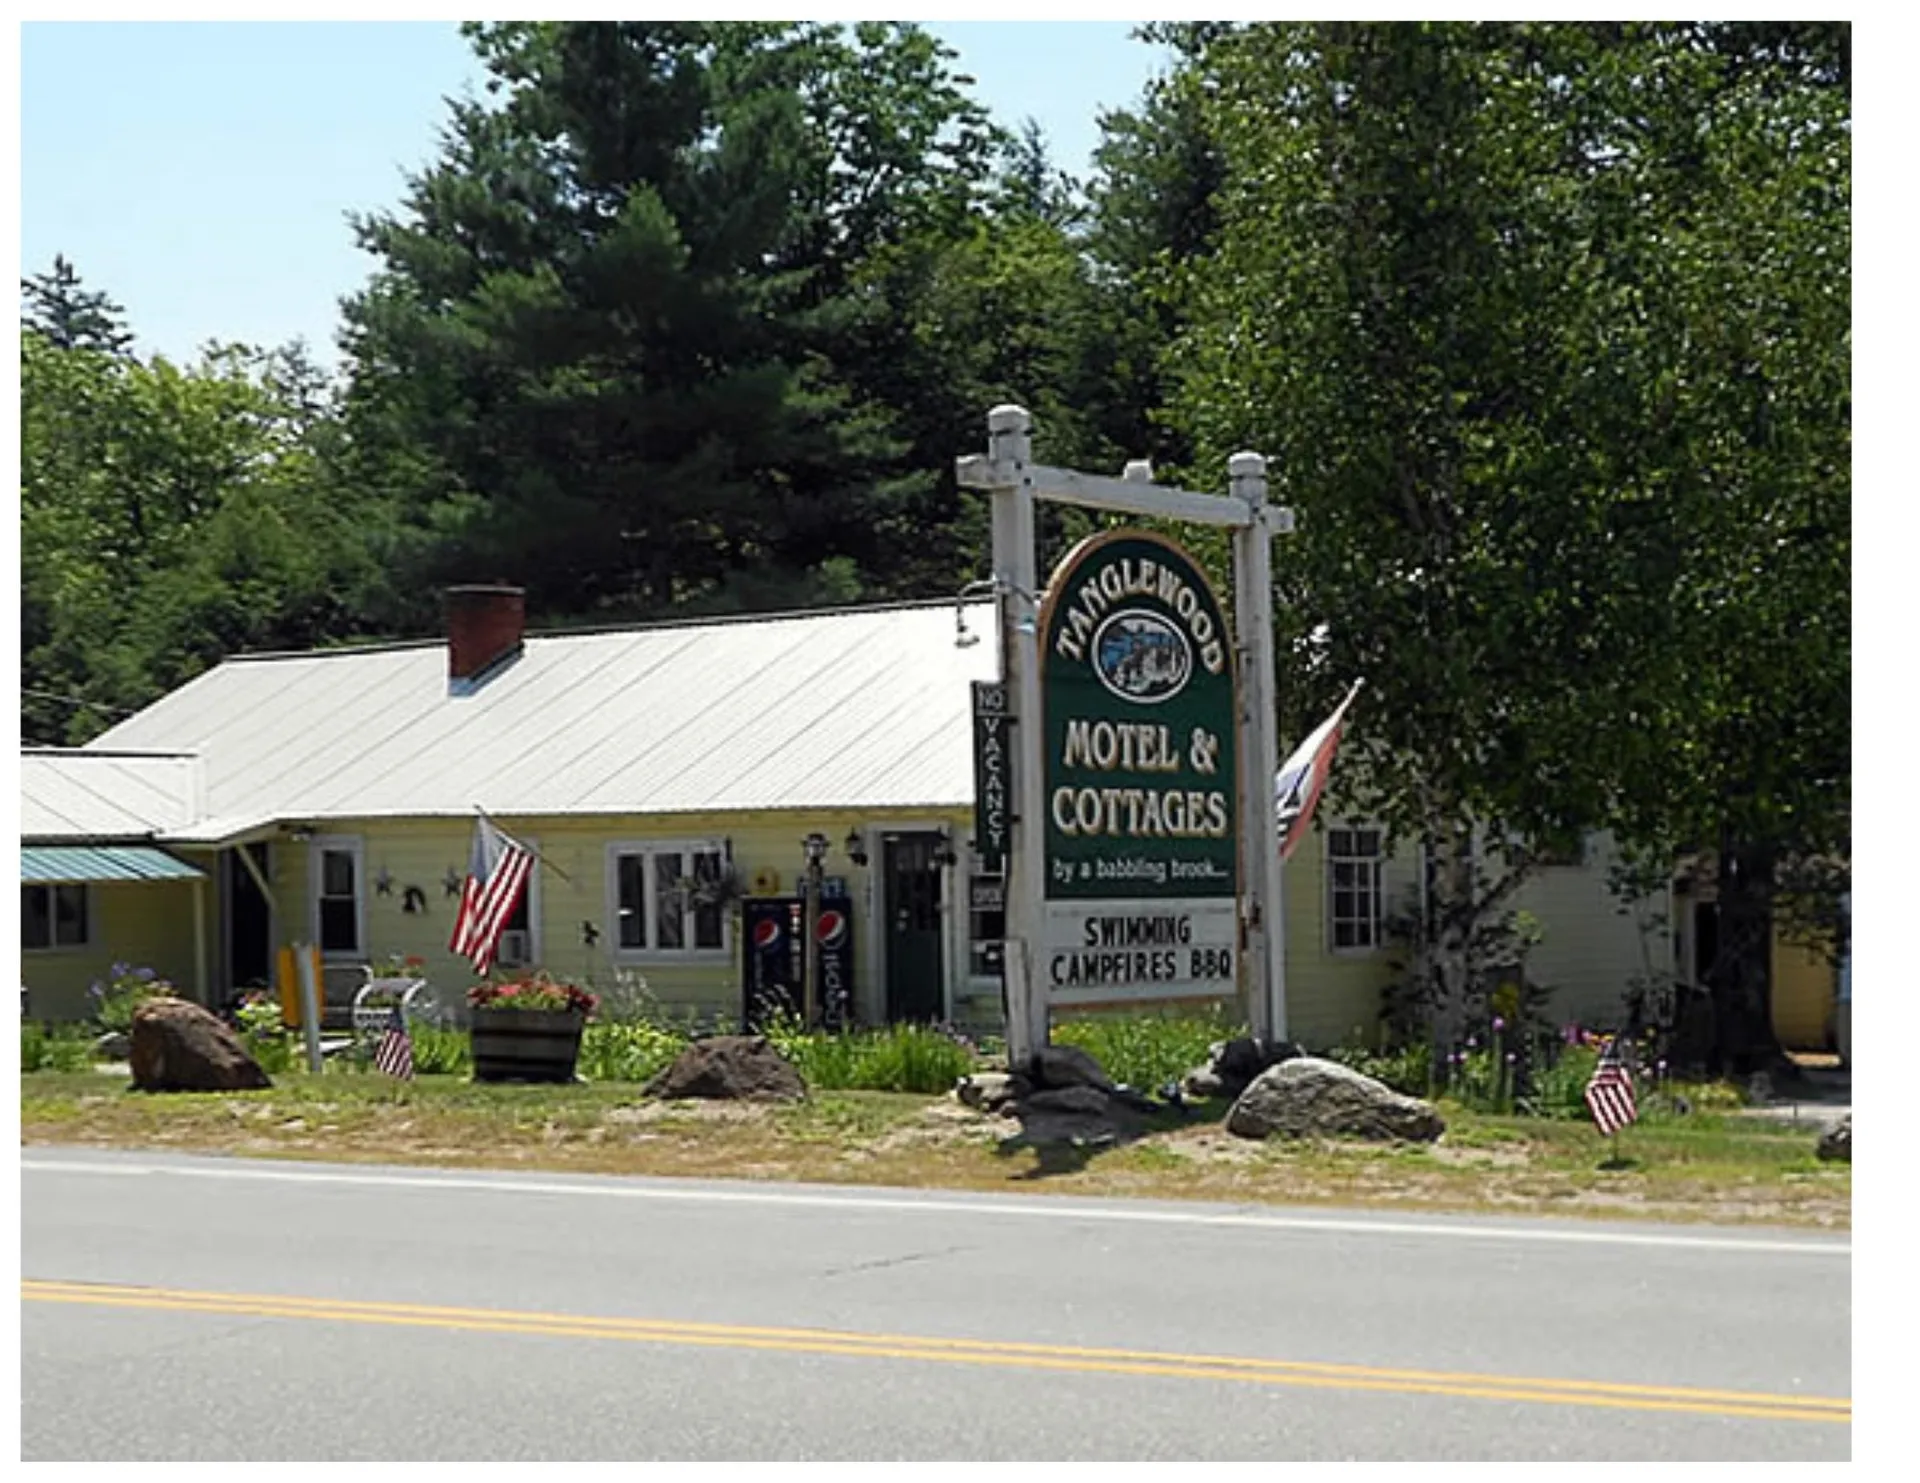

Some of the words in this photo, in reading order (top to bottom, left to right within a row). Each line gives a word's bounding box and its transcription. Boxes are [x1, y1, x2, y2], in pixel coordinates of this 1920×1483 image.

[1056, 557, 1224, 673] TANGLEWOOD
[1064, 720, 1180, 770] MOTEL
[1190, 728, 1218, 774] &
[984, 717, 1007, 848] VACANCY
[1052, 786, 1227, 837] COTTAGES
[1053, 856, 1074, 883] by
[1080, 862, 1091, 878] a
[1096, 856, 1167, 883] babbling
[1084, 915, 1192, 947] SWIMMING
[1051, 951, 1177, 986] CAMPFIRES
